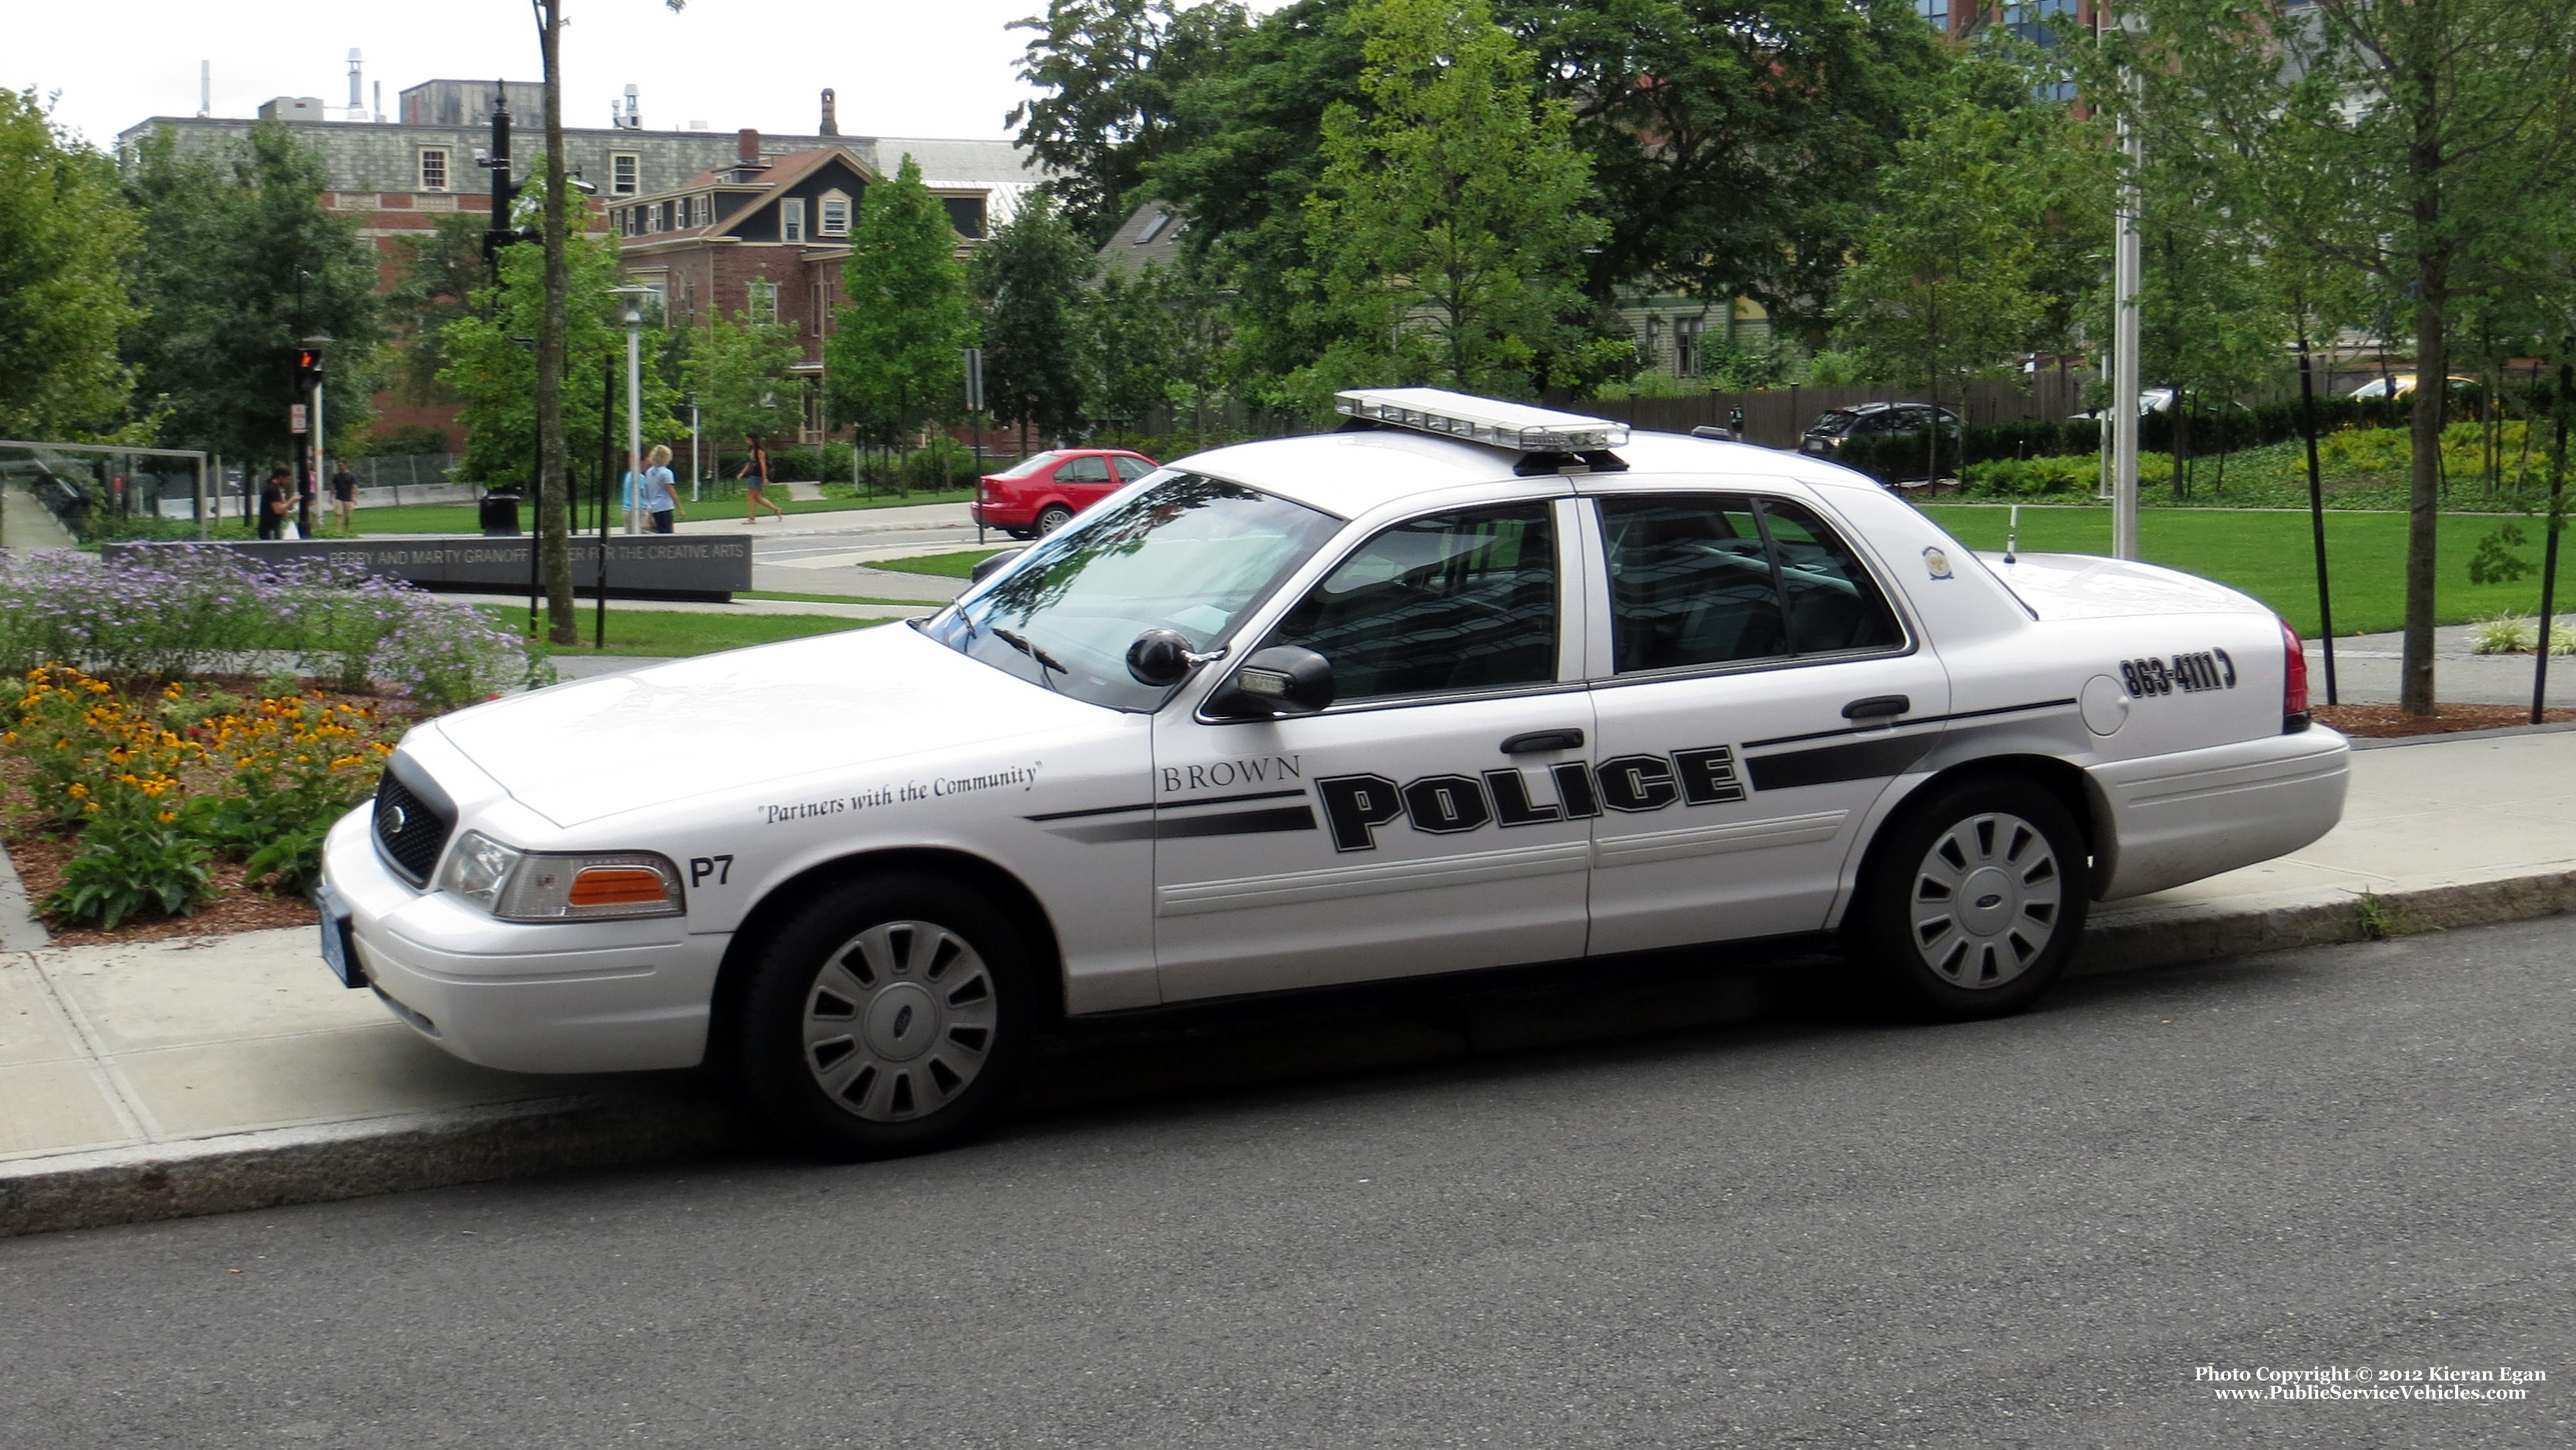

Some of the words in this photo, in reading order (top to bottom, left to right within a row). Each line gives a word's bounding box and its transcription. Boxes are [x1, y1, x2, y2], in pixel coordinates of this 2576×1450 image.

[329, 551, 374, 565] PERRY
[377, 551, 408, 564] AND
[412, 550, 461, 564] MARTY
[464, 548, 528, 563] GRANOFF
[618, 546, 645, 560] THE
[648, 545, 709, 559] CREATIVE
[712, 544, 744, 558] ARTS
[2119, 651, 2223, 698] 863-4111
[759, 798, 845, 824] "Partners
[851, 784, 893, 810] with
[899, 780, 928, 802] the
[933, 760, 1043, 796] Community"
[1164, 755, 1301, 792] BROWN
[1314, 745, 1745, 853] POLICE
[690, 854, 734, 887] P7
